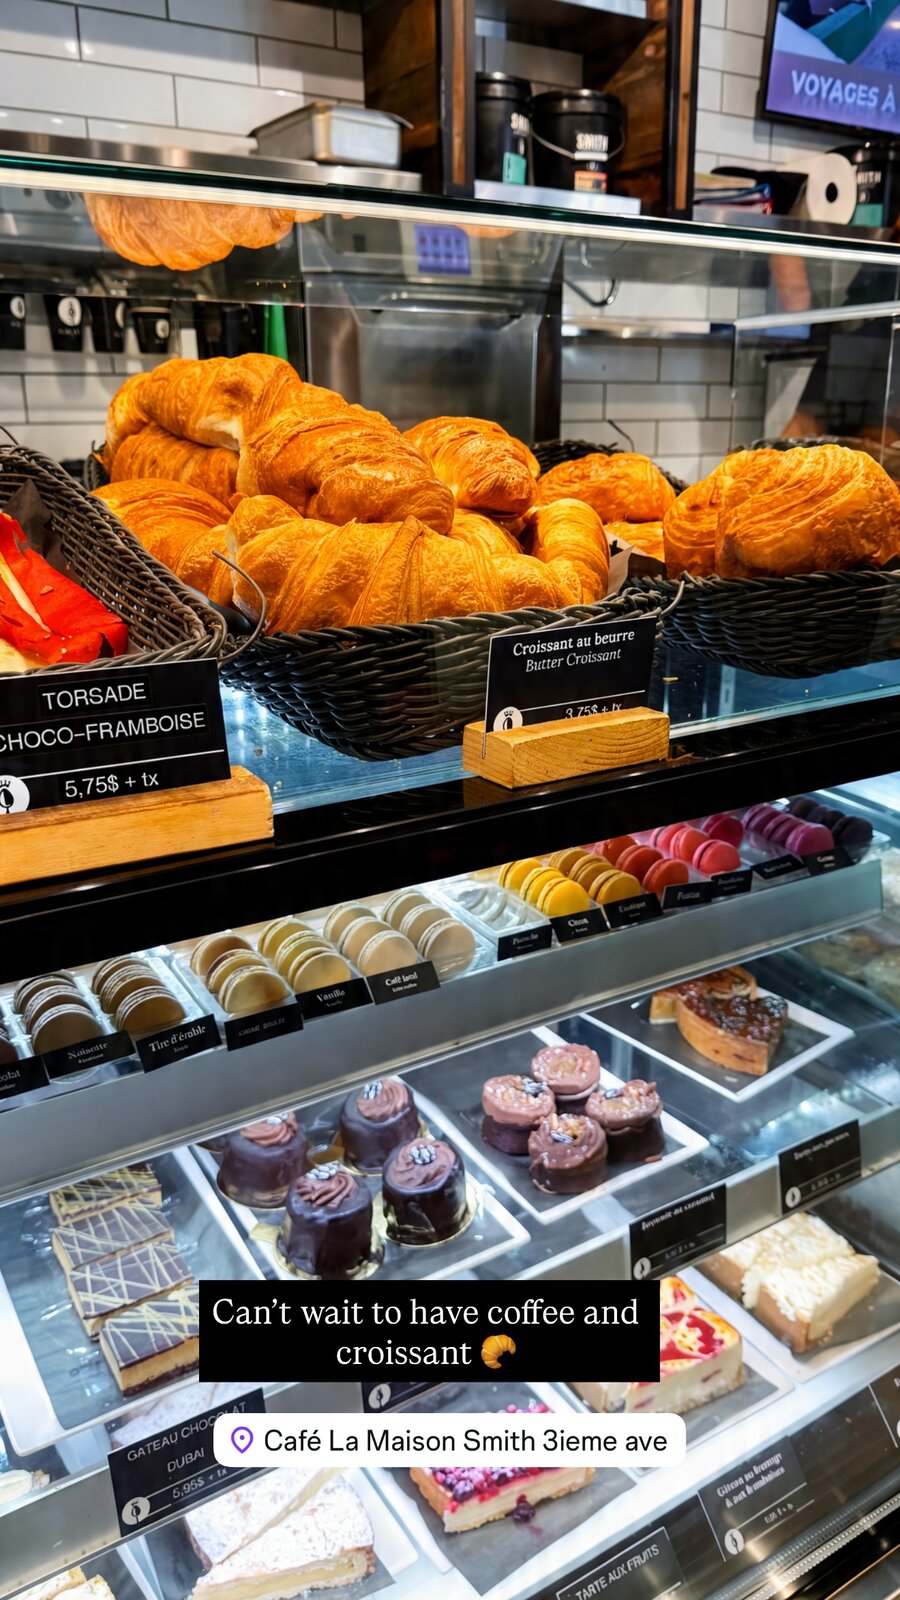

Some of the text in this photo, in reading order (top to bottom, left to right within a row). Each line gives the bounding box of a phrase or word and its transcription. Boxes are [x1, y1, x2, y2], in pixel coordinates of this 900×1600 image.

[792, 70, 896, 112] VOYAGES À
[513, 630, 635, 656] Croissant au beurre
[525, 649, 622, 672] Butter Croissant
[42, 682, 147, 711] TORSADE
[65, 772, 159, 799] 5,75$ + tx
[127, 1401, 247, 1462] GATEAU CHOCAT
[167, 1447, 206, 1473] DUBAI
[575, 1544, 660, 1600] TARTE AUX FRUITS
